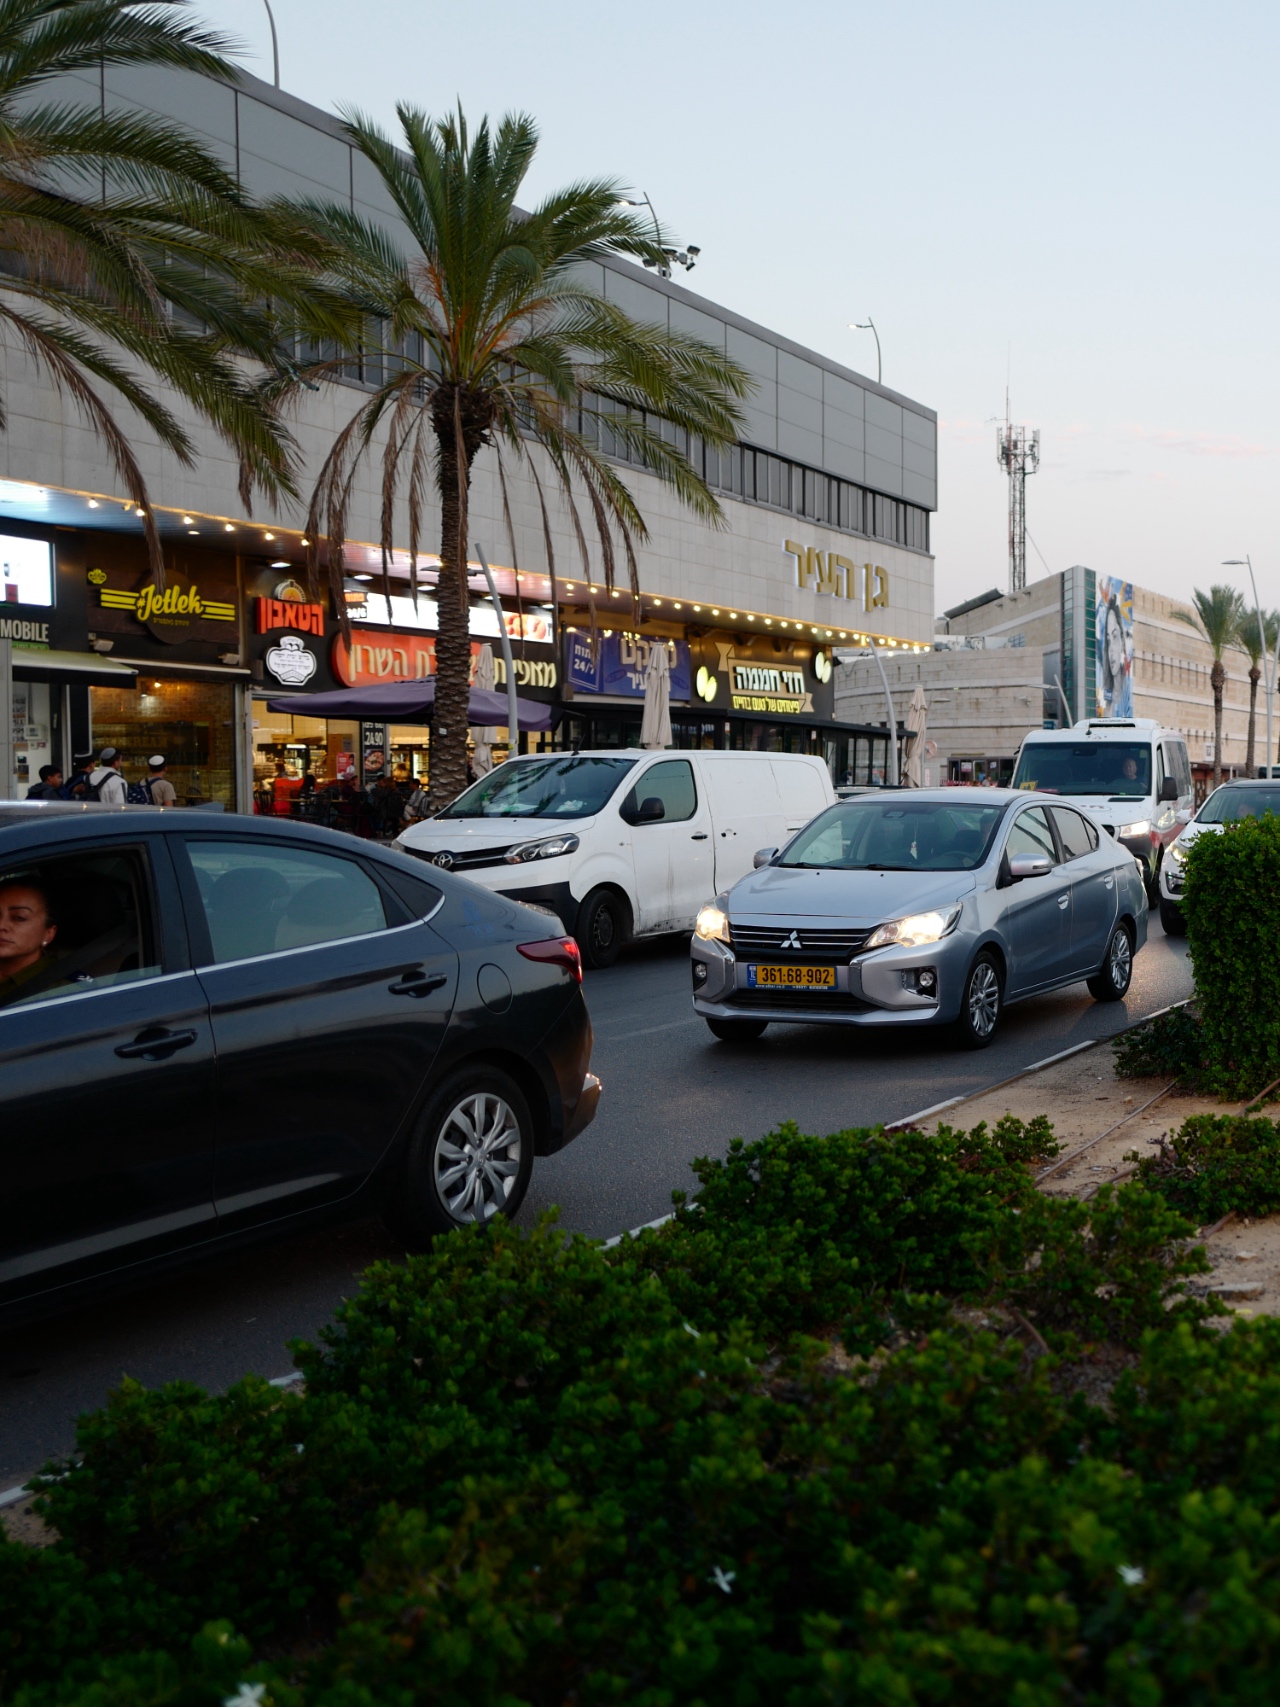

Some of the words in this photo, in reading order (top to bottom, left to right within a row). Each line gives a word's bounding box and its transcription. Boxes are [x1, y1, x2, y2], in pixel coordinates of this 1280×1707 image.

[783, 538, 856, 600] העיר
[863, 562, 890, 613] גן
[0, 618, 49, 642] MOBILE
[258, 596, 325, 637] הטאבון
[349, 644, 408, 682] השרון
[734, 666, 781, 692] חממה
[781, 670, 806, 694] חזי
